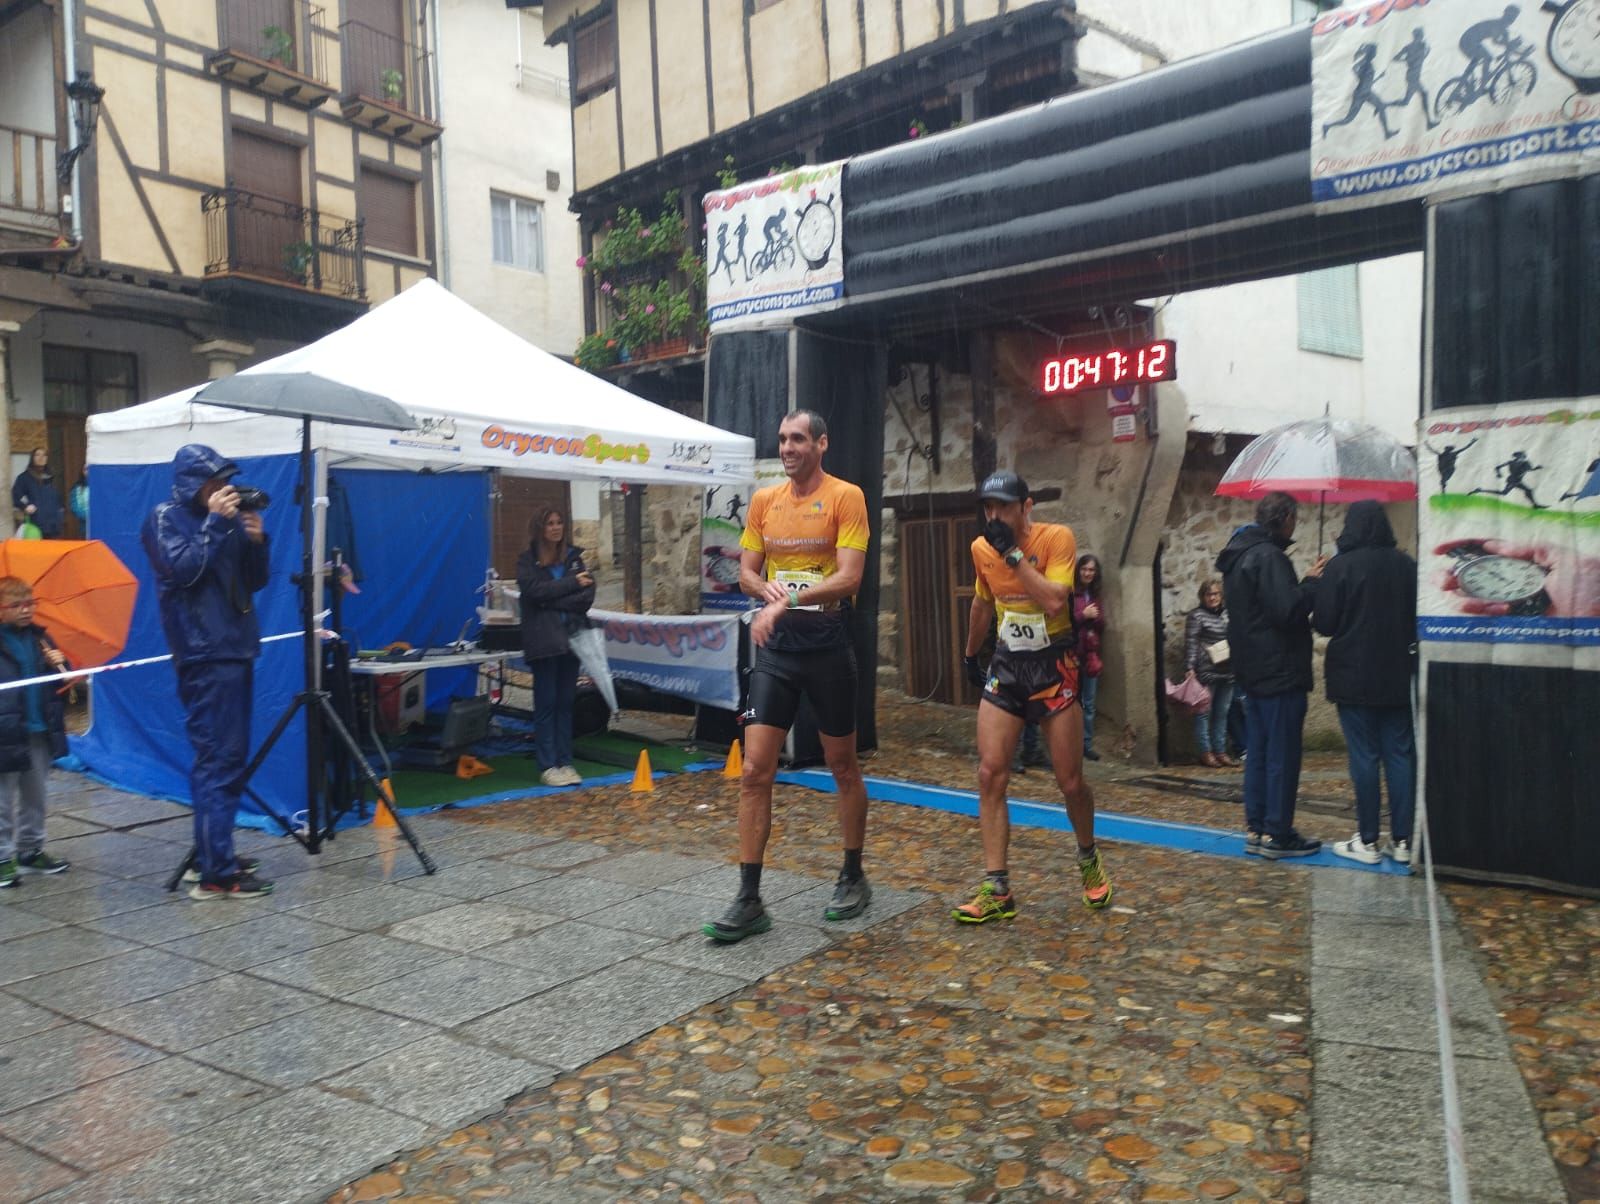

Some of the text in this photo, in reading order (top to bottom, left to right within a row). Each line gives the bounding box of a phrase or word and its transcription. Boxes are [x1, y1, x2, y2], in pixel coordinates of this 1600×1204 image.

[711, 286, 836, 320] www.orycronsport.com
[1044, 344, 1167, 392] 00:47:12
[481, 423, 652, 464] OrycronSport
[1009, 623, 1035, 640] 30
